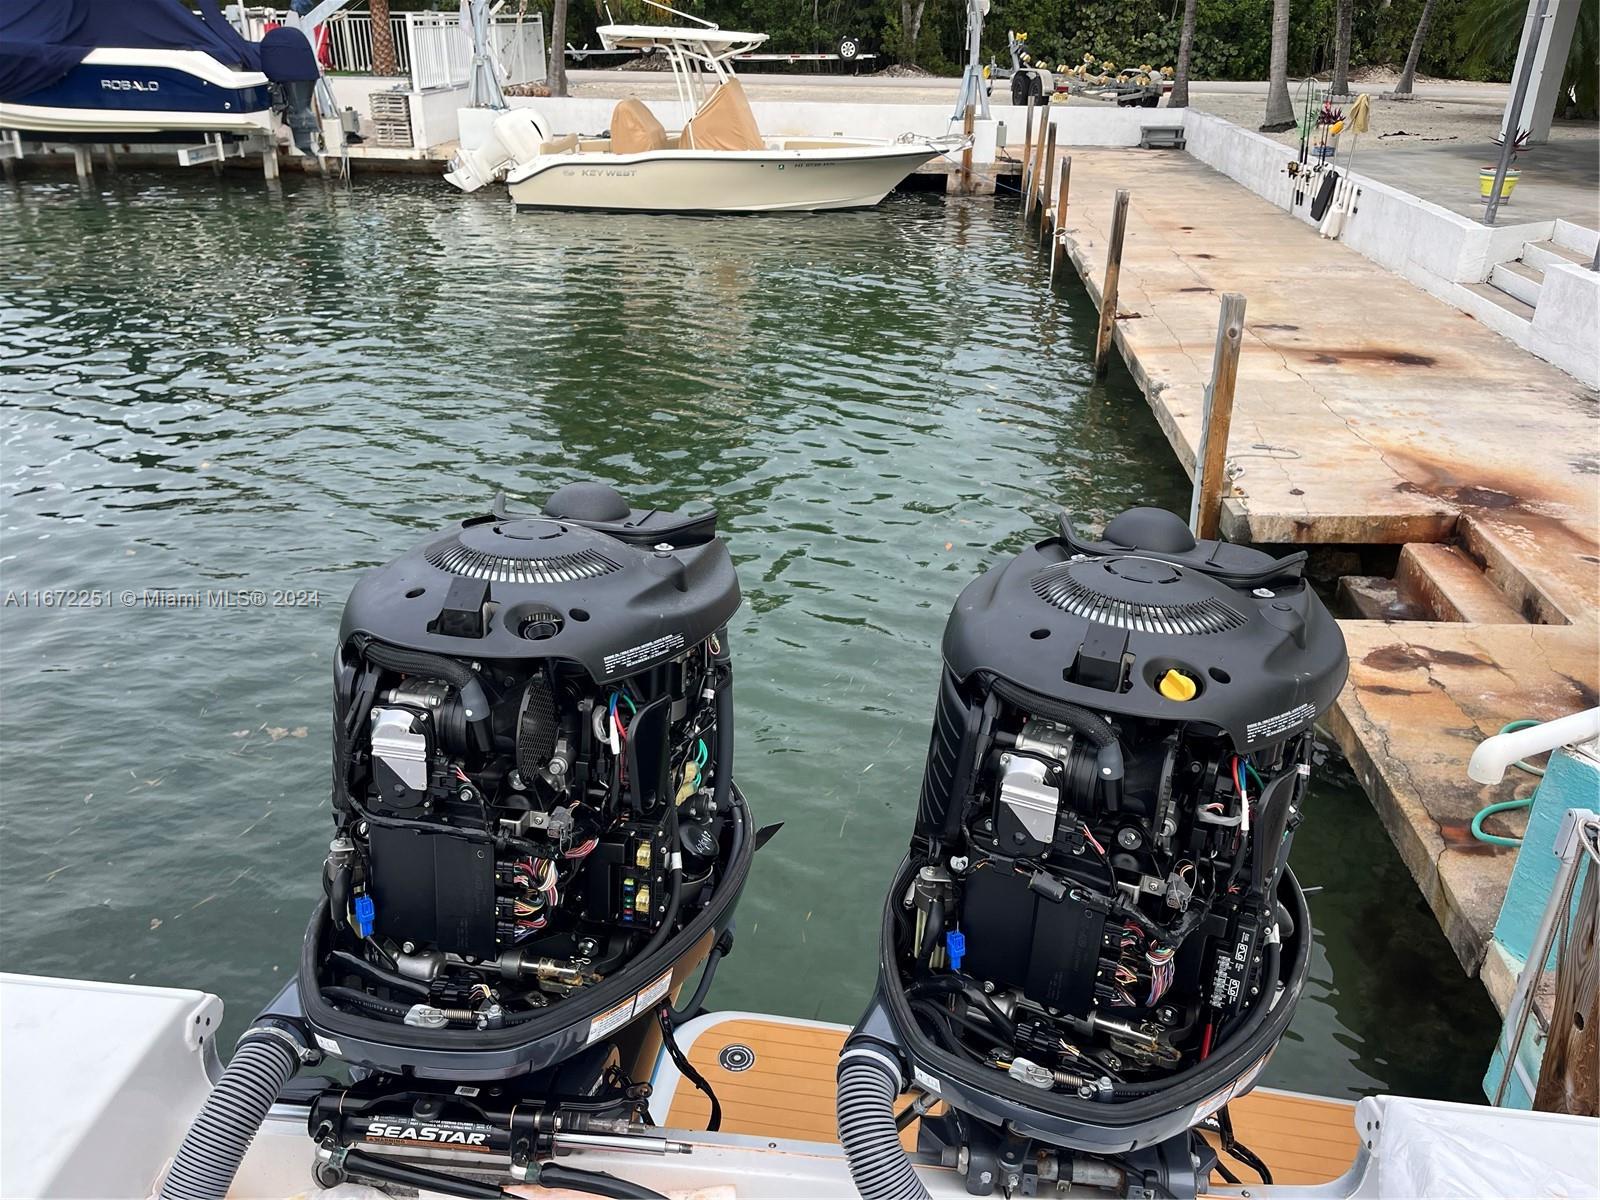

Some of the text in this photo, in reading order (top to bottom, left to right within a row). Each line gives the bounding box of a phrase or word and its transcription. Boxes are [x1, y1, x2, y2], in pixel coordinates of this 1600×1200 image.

[101, 79, 159, 91] ROBALO
[581, 168, 637, 177] KEY WEST
